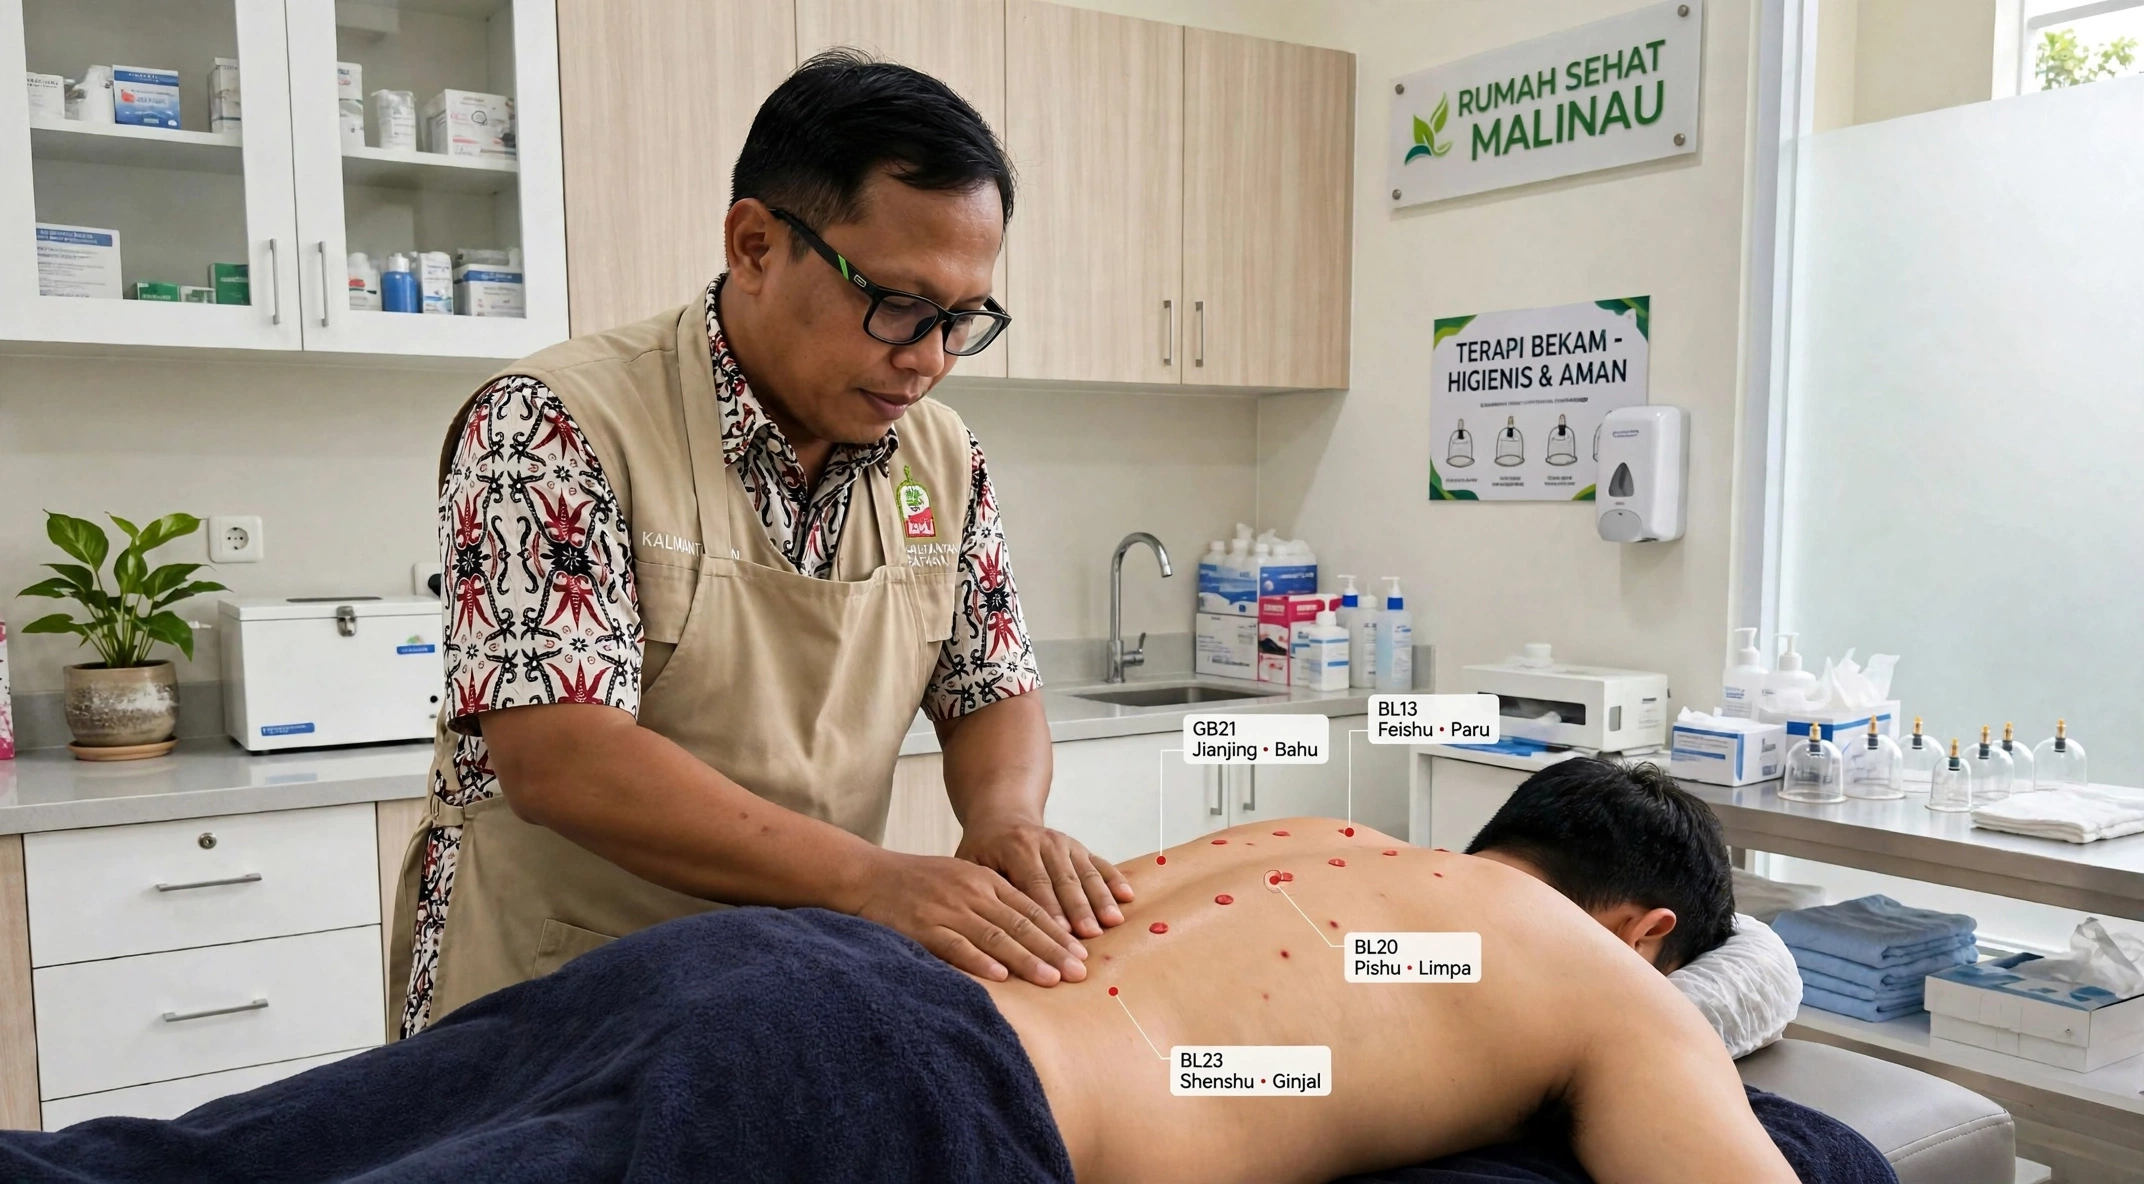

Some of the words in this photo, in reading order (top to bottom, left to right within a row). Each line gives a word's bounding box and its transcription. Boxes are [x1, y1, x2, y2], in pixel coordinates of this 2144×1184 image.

[1458, 67, 1556, 117] RUMAH
[1565, 39, 1666, 91] SEHAT
[1471, 79, 1664, 161] MALINAU
[1456, 336, 1524, 364] TERAPI
[1531, 329, 1607, 358] BEKAM
[1448, 365, 1533, 393] HIGIENIS
[1538, 364, 1553, 388] &
[1559, 358, 1627, 387] AMAN
